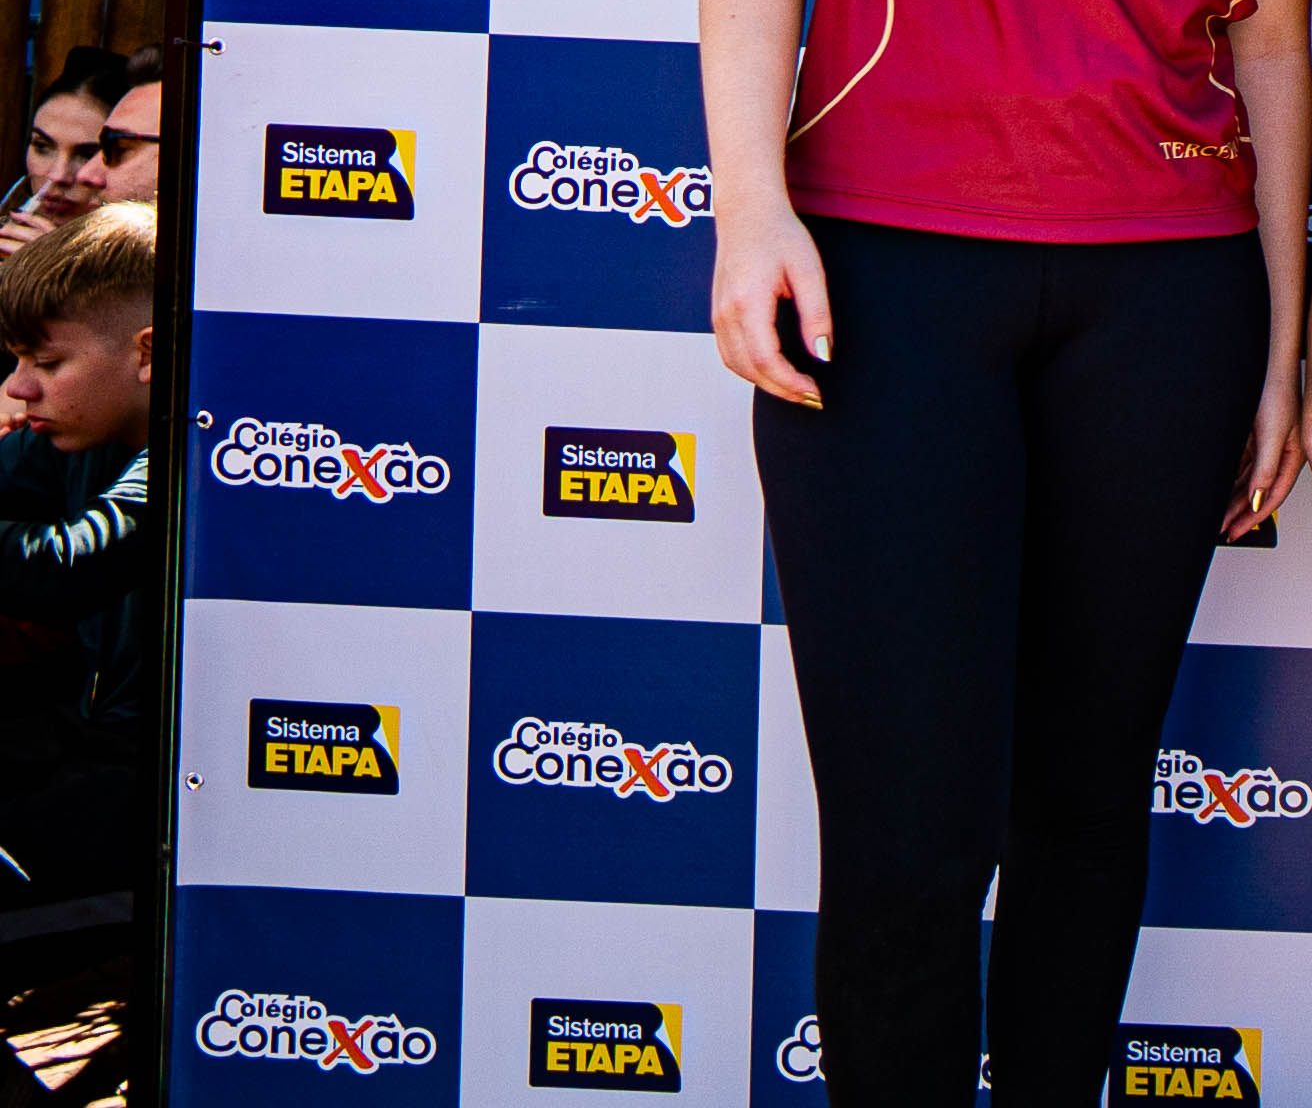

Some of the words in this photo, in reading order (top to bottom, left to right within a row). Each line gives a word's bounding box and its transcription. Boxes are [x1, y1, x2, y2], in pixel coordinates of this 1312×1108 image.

[282, 141, 377, 167] Sistema
[533, 146, 634, 176] Colégio
[277, 167, 398, 204] ETAPA
[513, 169, 713, 222] ConeXã
[234, 422, 336, 452] Colégio
[562, 445, 658, 469] Sistema
[557, 470, 679, 506] ETAPA
[266, 718, 361, 742] Sistema
[516, 722, 619, 751] Colégio
[262, 743, 382, 778] ETAPA
[221, 994, 323, 1023] Colégio
[548, 1016, 643, 1040] Sistema
[543, 1041, 664, 1077] ETAPA
[1127, 1041, 1222, 1065] Sistema
[1123, 1066, 1243, 1101] ETAPA
